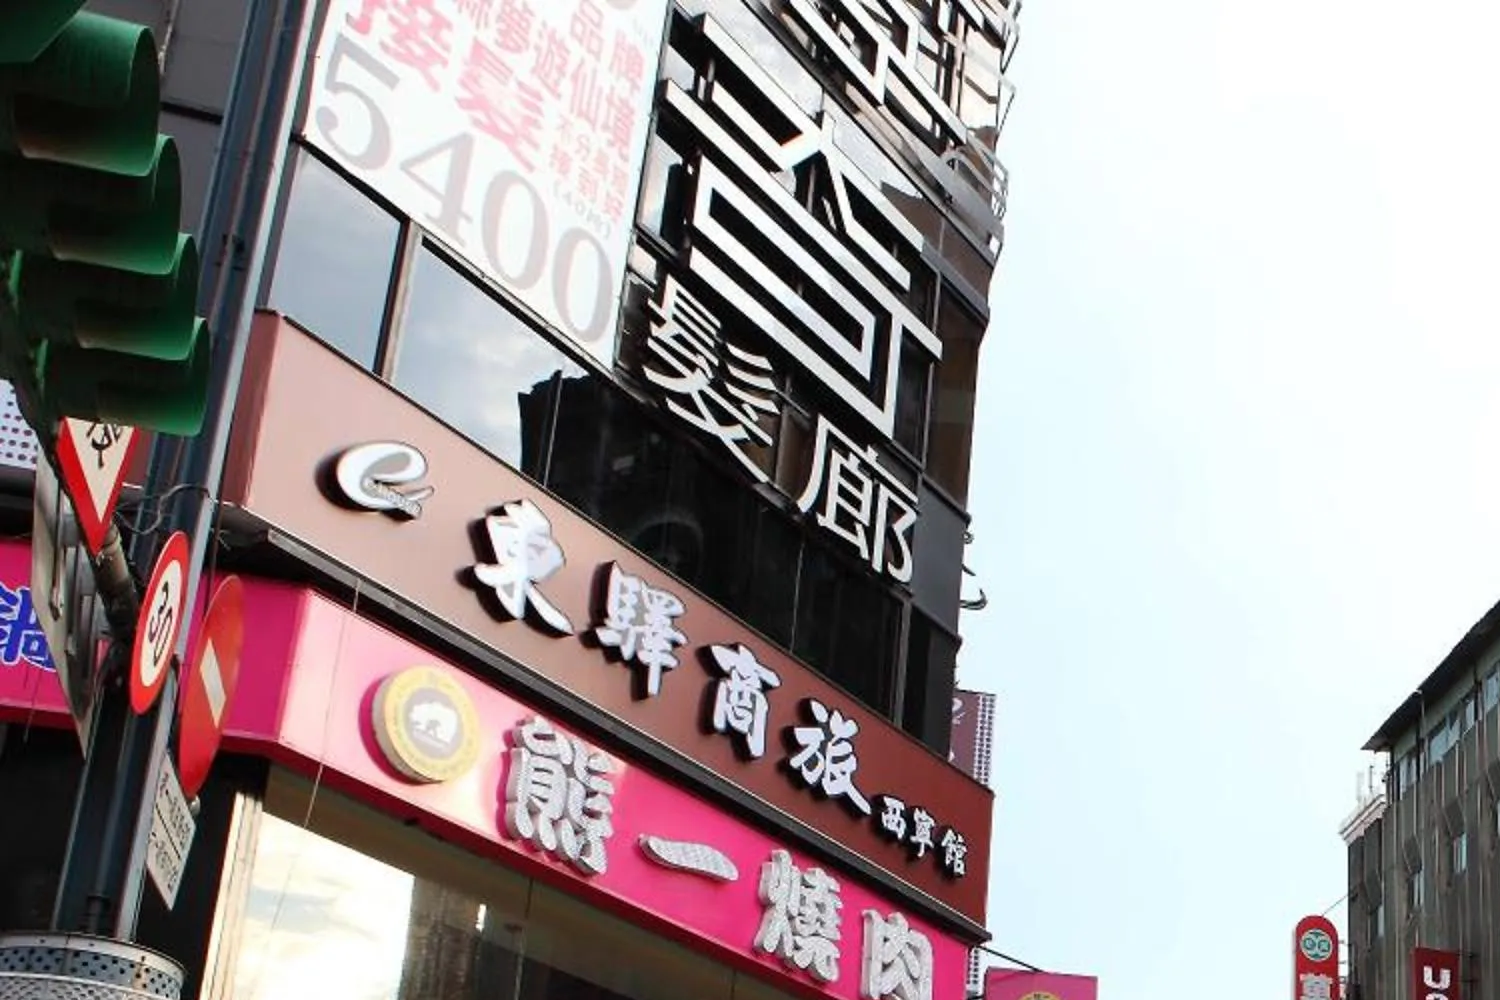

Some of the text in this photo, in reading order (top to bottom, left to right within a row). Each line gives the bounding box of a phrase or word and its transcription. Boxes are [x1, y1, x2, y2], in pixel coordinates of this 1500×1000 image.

[315, 32, 614, 344] 5400
[475, 498, 969, 878] 東驛商旅 西寧館
